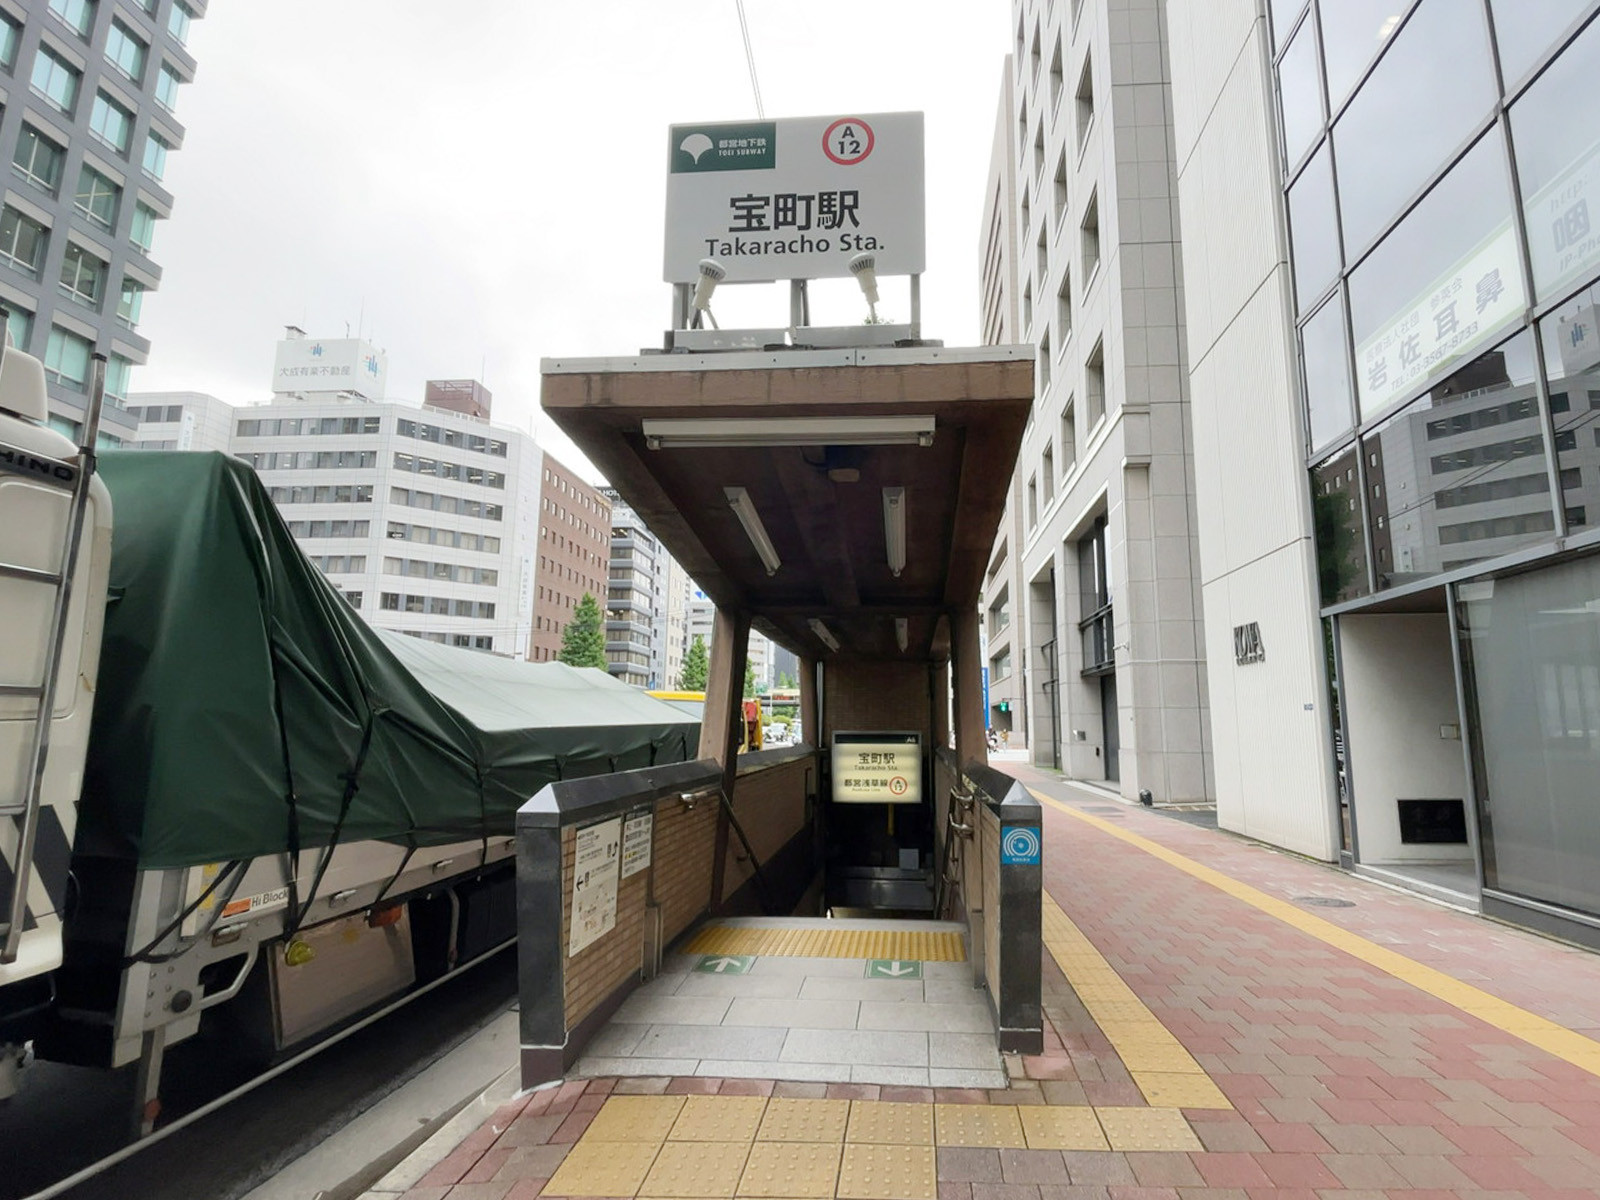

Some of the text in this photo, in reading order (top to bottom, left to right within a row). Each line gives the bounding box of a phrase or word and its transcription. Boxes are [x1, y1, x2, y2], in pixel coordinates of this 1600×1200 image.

[841, 126, 856, 138] A
[718, 138, 766, 149] 都営地下鉄
[837, 140, 861, 155] 12
[736, 147, 766, 156] SUBWAY
[729, 191, 860, 232] 宝町駅
[705, 233, 885, 256] Takaracho Sta.
[1368, 267, 1505, 391] 岩佐耳鼻
[858, 752, 895, 765] 宝町駅
[844, 778, 888, 787] 都営浅草線
